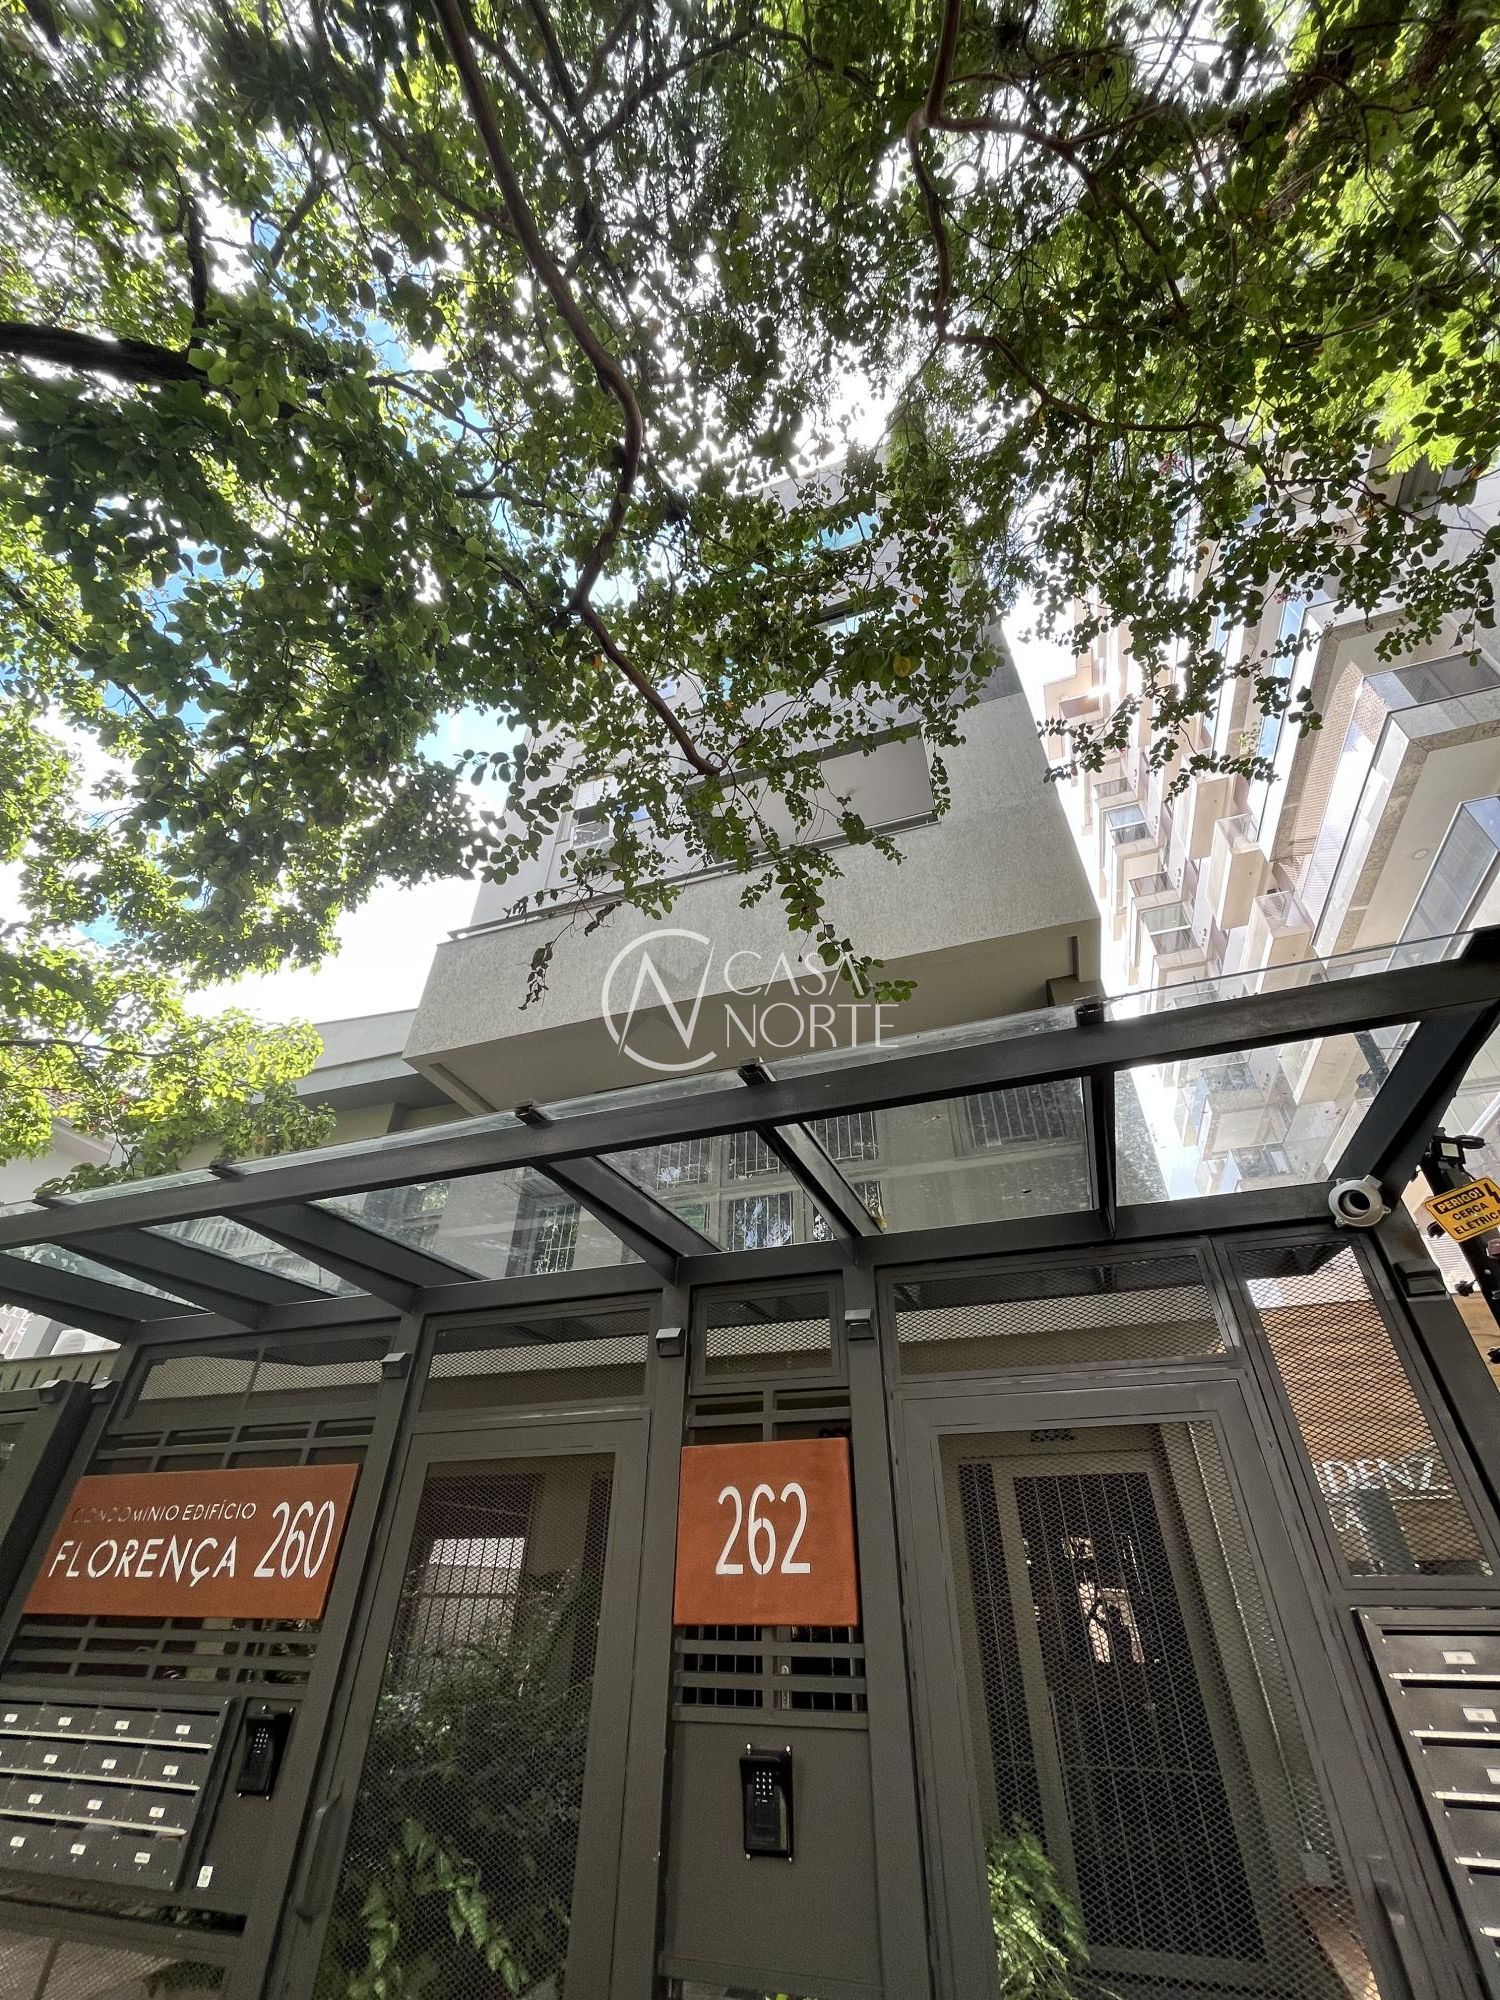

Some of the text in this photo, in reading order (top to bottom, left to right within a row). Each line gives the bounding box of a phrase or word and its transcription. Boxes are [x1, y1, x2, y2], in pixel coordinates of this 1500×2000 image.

[1437, 1189, 1482, 1212] PERIGO!
[1452, 1203, 1489, 1221] CERCA
[1454, 1209, 1500, 1234] ELÉTRIC
[182, 1499, 257, 1521] EDIFÍCIO
[715, 1482, 811, 1575] 262
[48, 1500, 335, 1587] FLORENÇA 260
